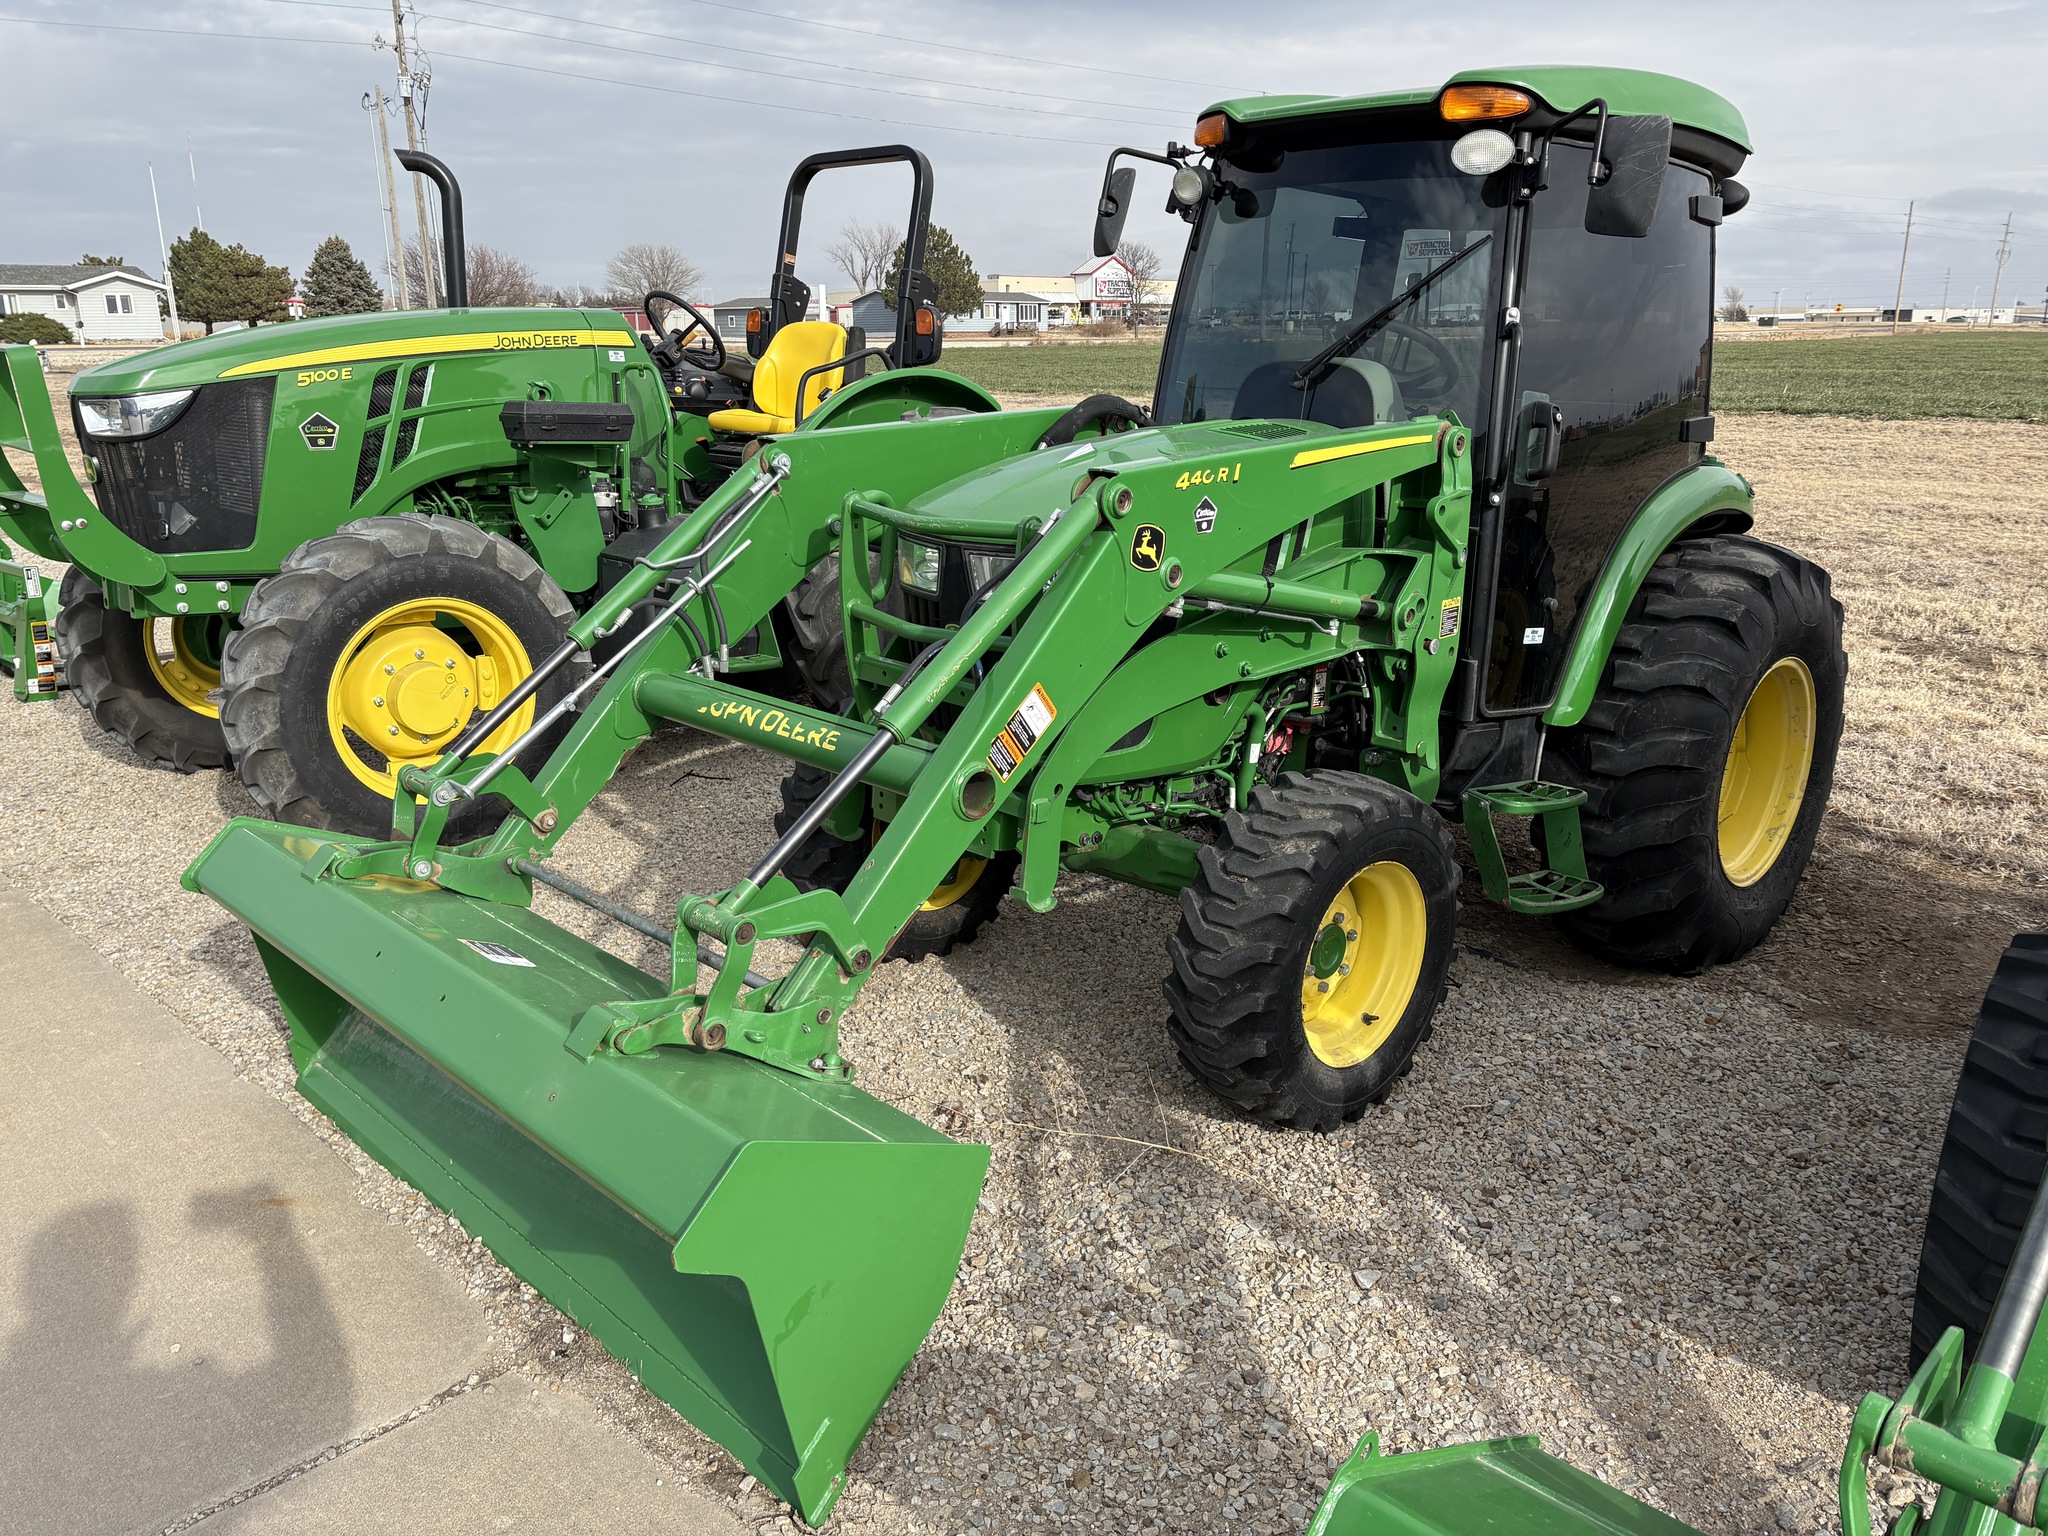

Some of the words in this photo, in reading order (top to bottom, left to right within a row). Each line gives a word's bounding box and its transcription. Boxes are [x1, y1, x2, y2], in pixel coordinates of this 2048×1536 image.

[1419, 248, 1443, 256] SUPPLY
[494, 335, 531, 348] JOHN
[533, 333, 578, 347] DEERE
